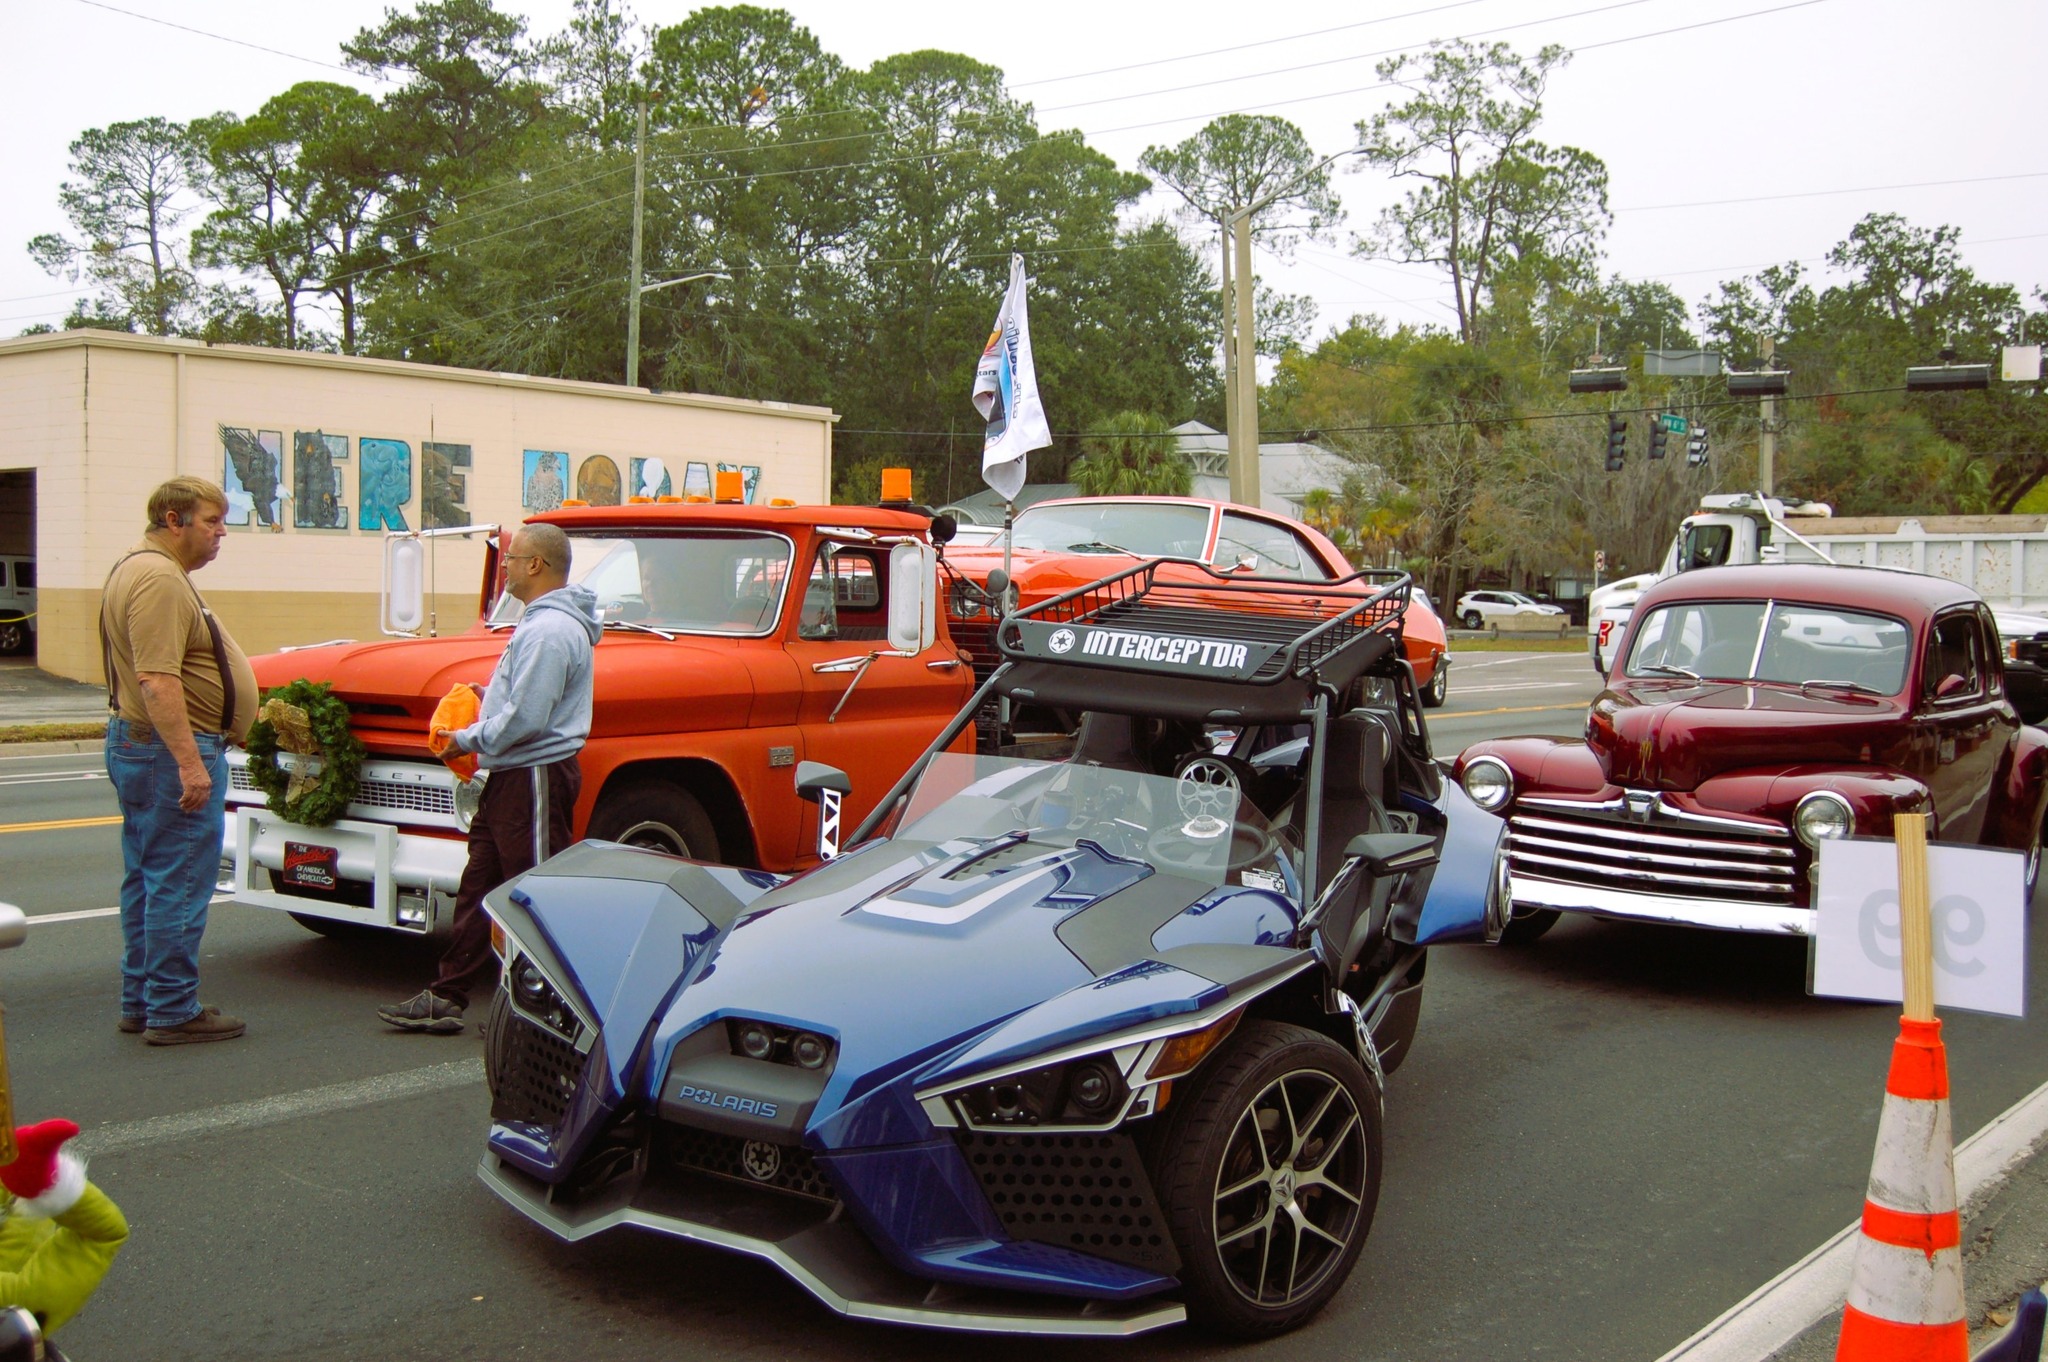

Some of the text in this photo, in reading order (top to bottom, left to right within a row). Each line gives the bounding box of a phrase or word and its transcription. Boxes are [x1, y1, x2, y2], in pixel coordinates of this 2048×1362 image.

[218, 423, 472, 540] HERE
[1082, 630, 1248, 669] INTERCEPTOR
[303, 866, 326, 875] AMERICA
[679, 1085, 778, 1118] POLARIS
